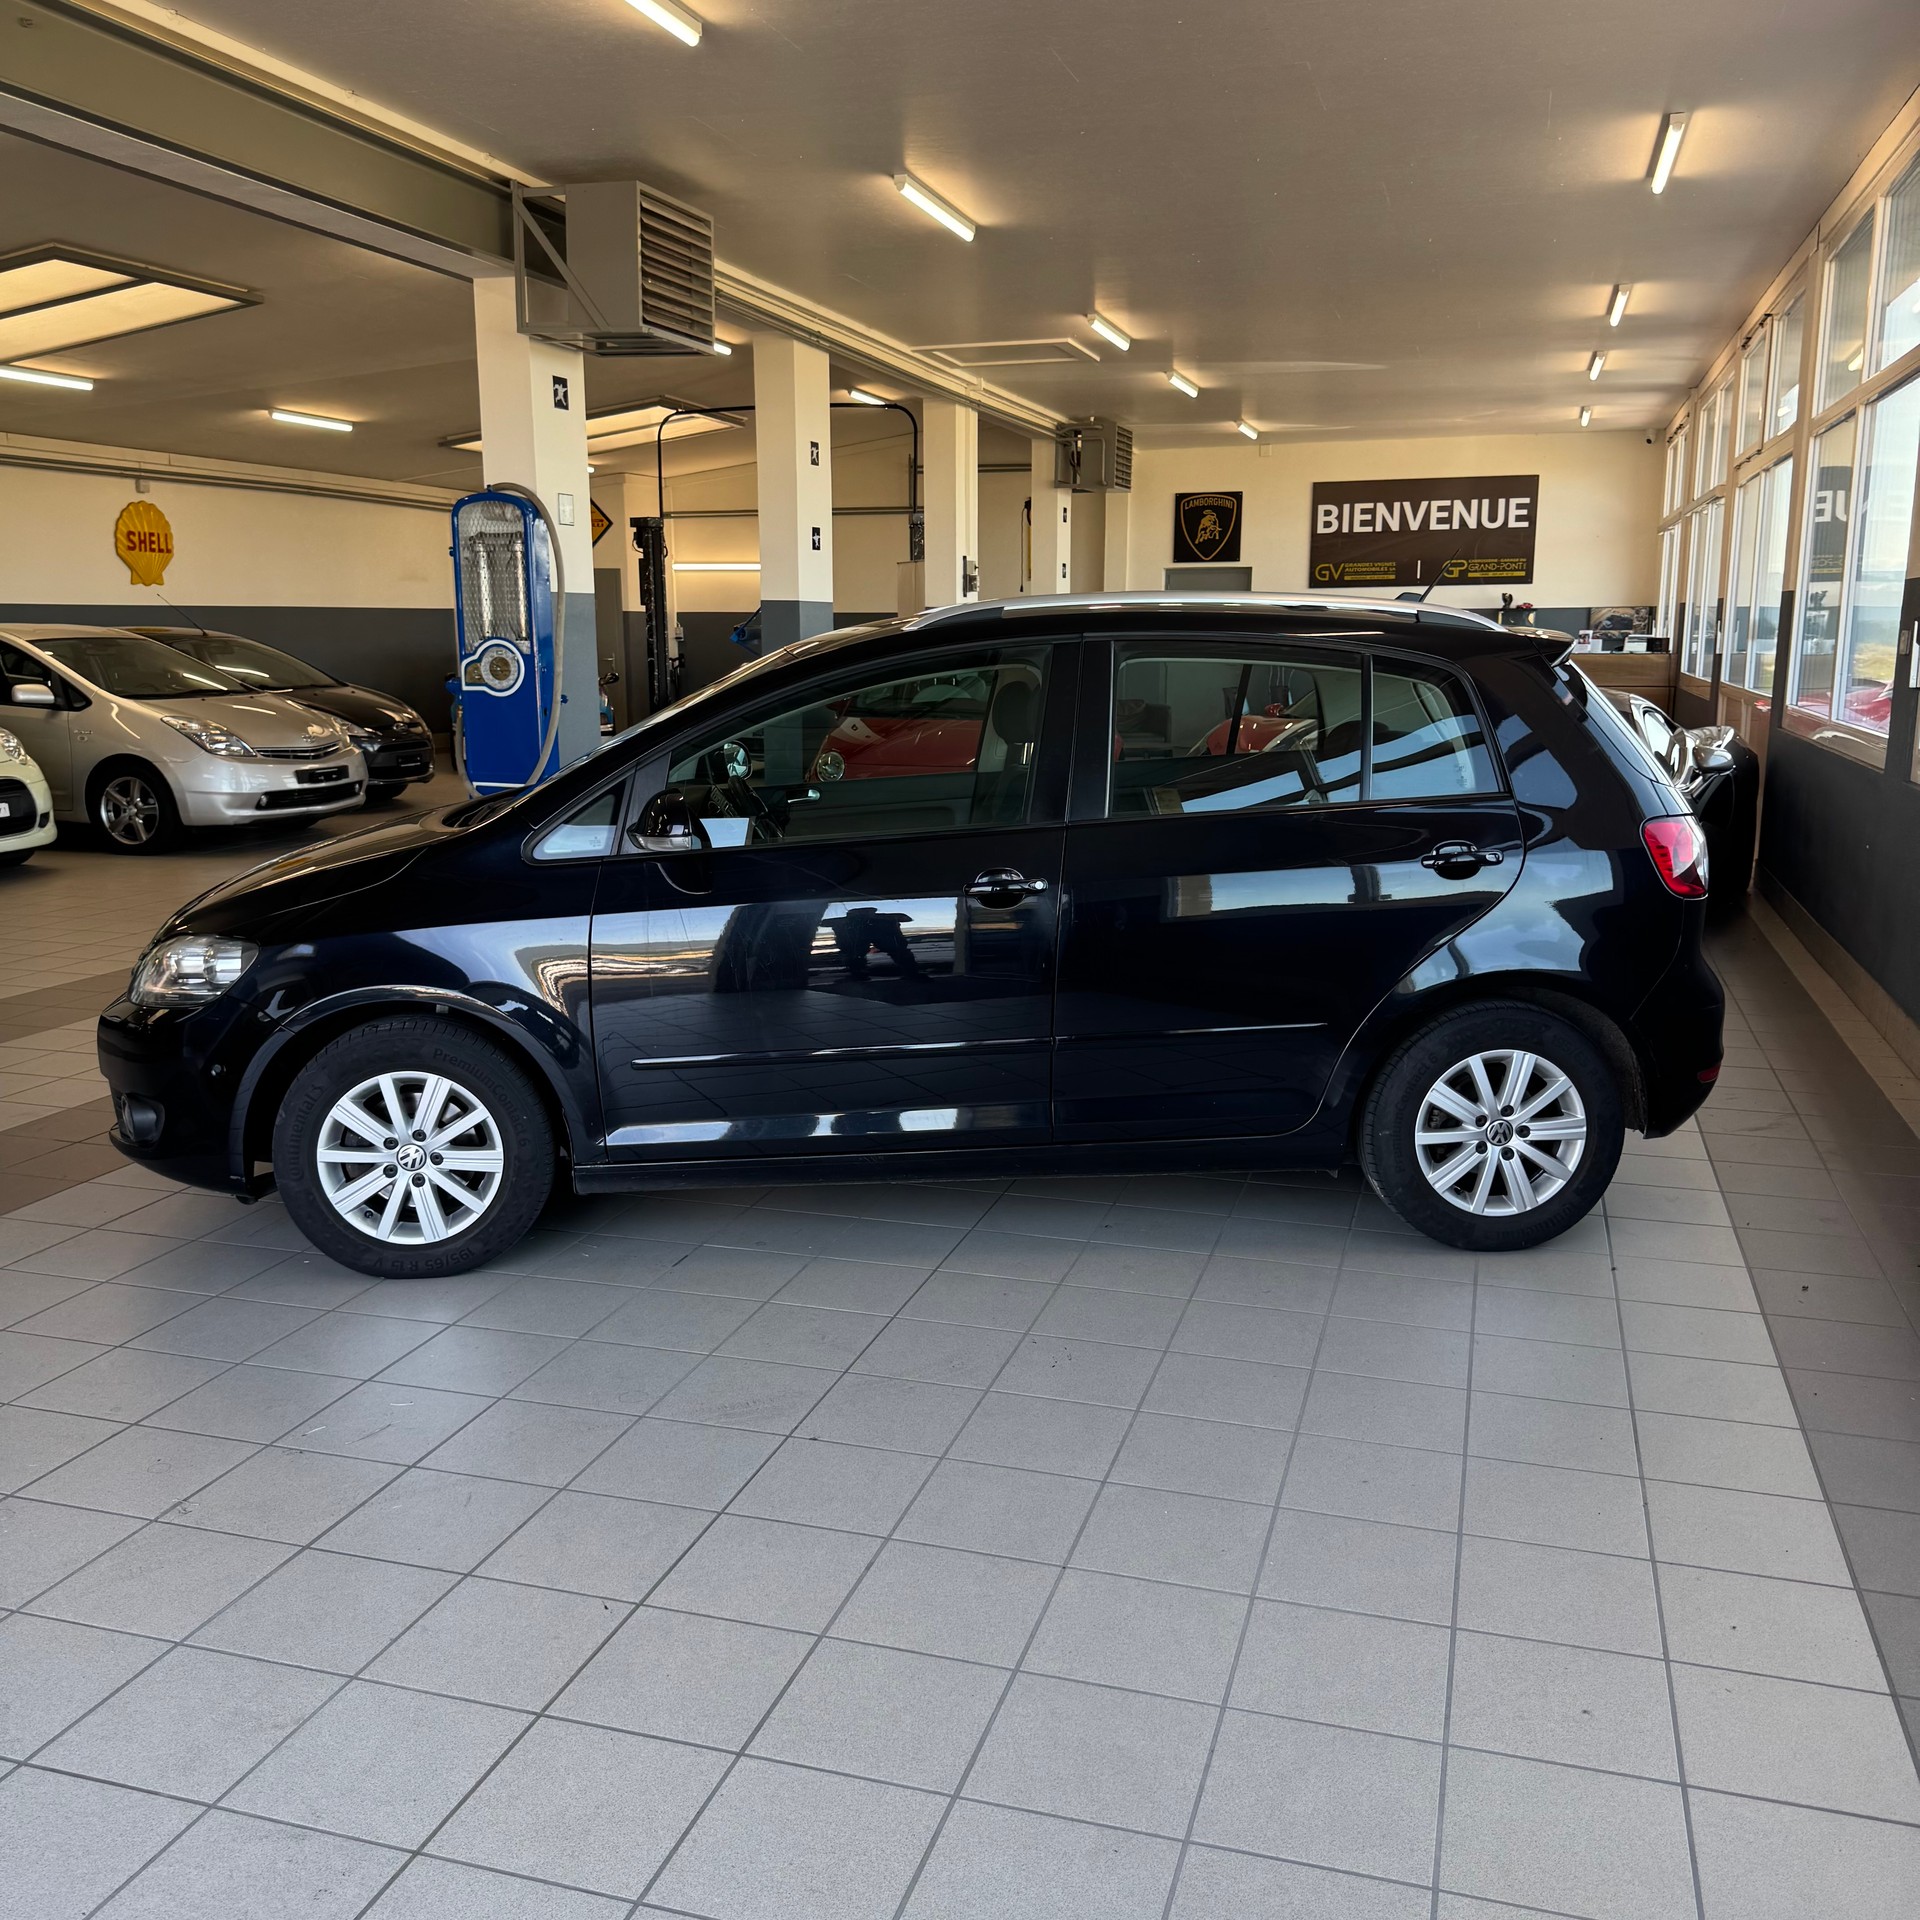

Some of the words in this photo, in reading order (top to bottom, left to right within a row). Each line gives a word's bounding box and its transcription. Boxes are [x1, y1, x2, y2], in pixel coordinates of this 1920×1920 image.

[1184, 497, 1233, 510] LAMBORGHINI
[1316, 497, 1531, 534] BIENVENUE
[126, 530, 172, 554] SHELL
[1315, 563, 1344, 581] GV
[1468, 562, 1524, 571] GRAND-PONT
[433, 1047, 528, 1137] PremiumContact
[518, 1138, 529, 1148] 6
[409, 1260, 419, 1272] R
[424, 1247, 476, 1272] 195/65
